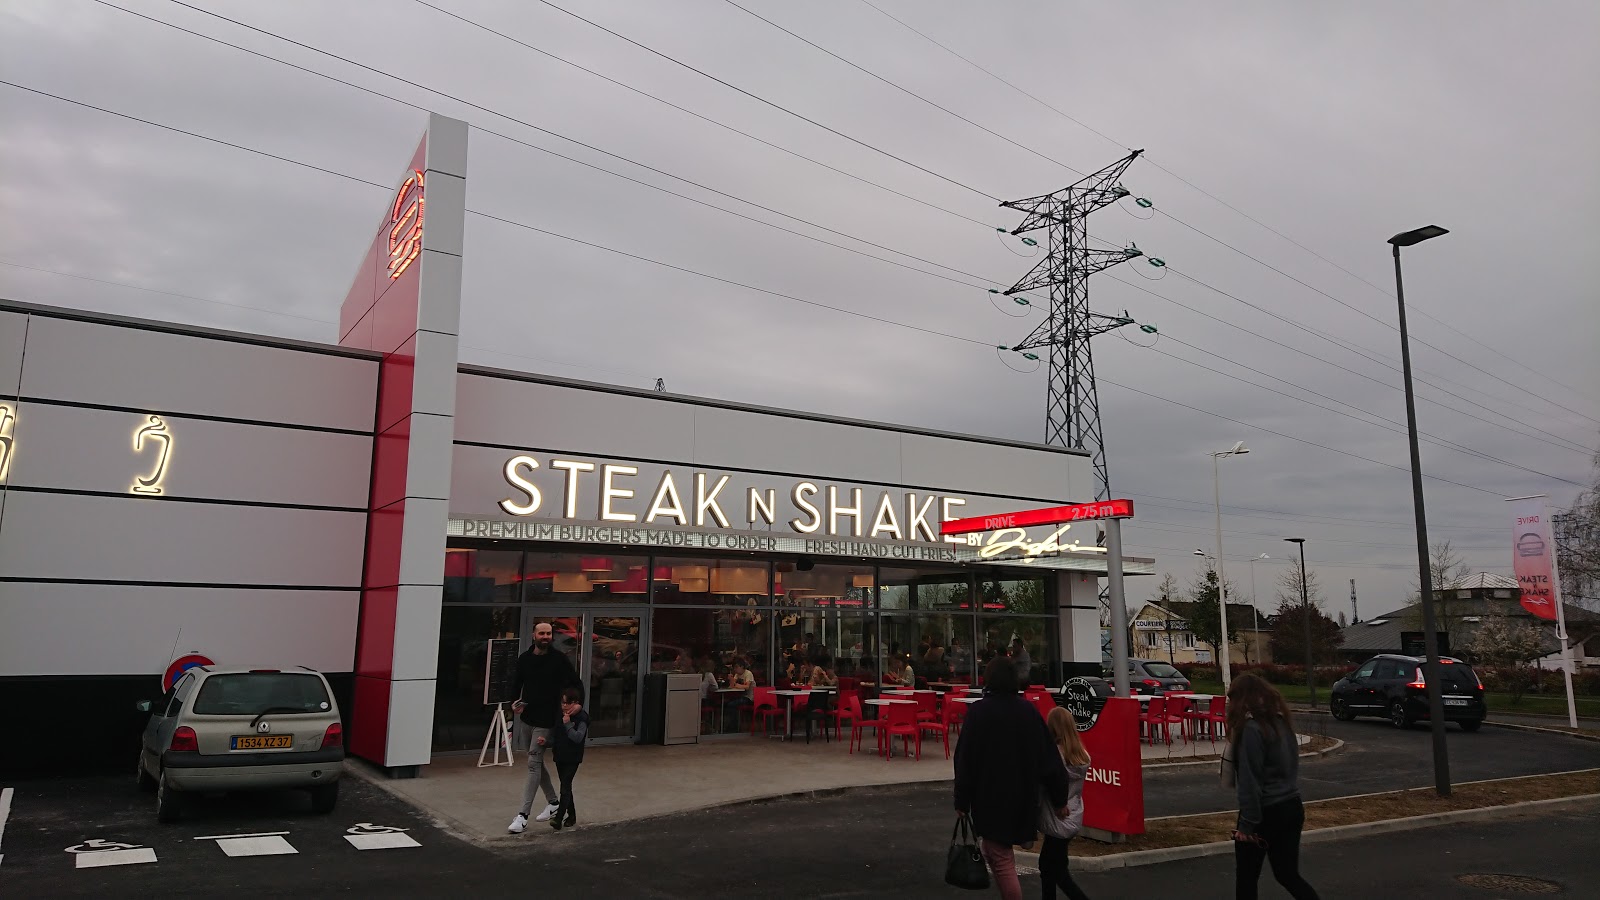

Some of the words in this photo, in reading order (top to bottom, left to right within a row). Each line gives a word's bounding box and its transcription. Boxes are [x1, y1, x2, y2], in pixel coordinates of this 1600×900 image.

[498, 455, 732, 528] STEAK
[746, 487, 776, 524] N
[788, 481, 968, 544] SHAKE
[1071, 505, 1098, 520] 2.75
[1099, 504, 1114, 517] m
[985, 515, 1016, 530] DRIVE
[463, 519, 555, 541] PREMIUM
[560, 525, 642, 545] BURGERS
[647, 529, 693, 548] MADE
[700, 532, 721, 548] TO
[726, 535, 777, 551] ORDER
[967, 531, 983, 546] BY
[806, 539, 848, 555] FRESH
[851, 542, 888, 557] HAND
[892, 545, 918, 559] CUT
[1067, 687, 1090, 701] Steak
[1067, 703, 1091, 717] Shake
[1076, 701, 1082, 709] n
[240, 737, 262, 748] 1534
[264, 737, 276, 747] XZ
[277, 737, 289, 747] 37
[1085, 767, 1121, 787] ENUE
